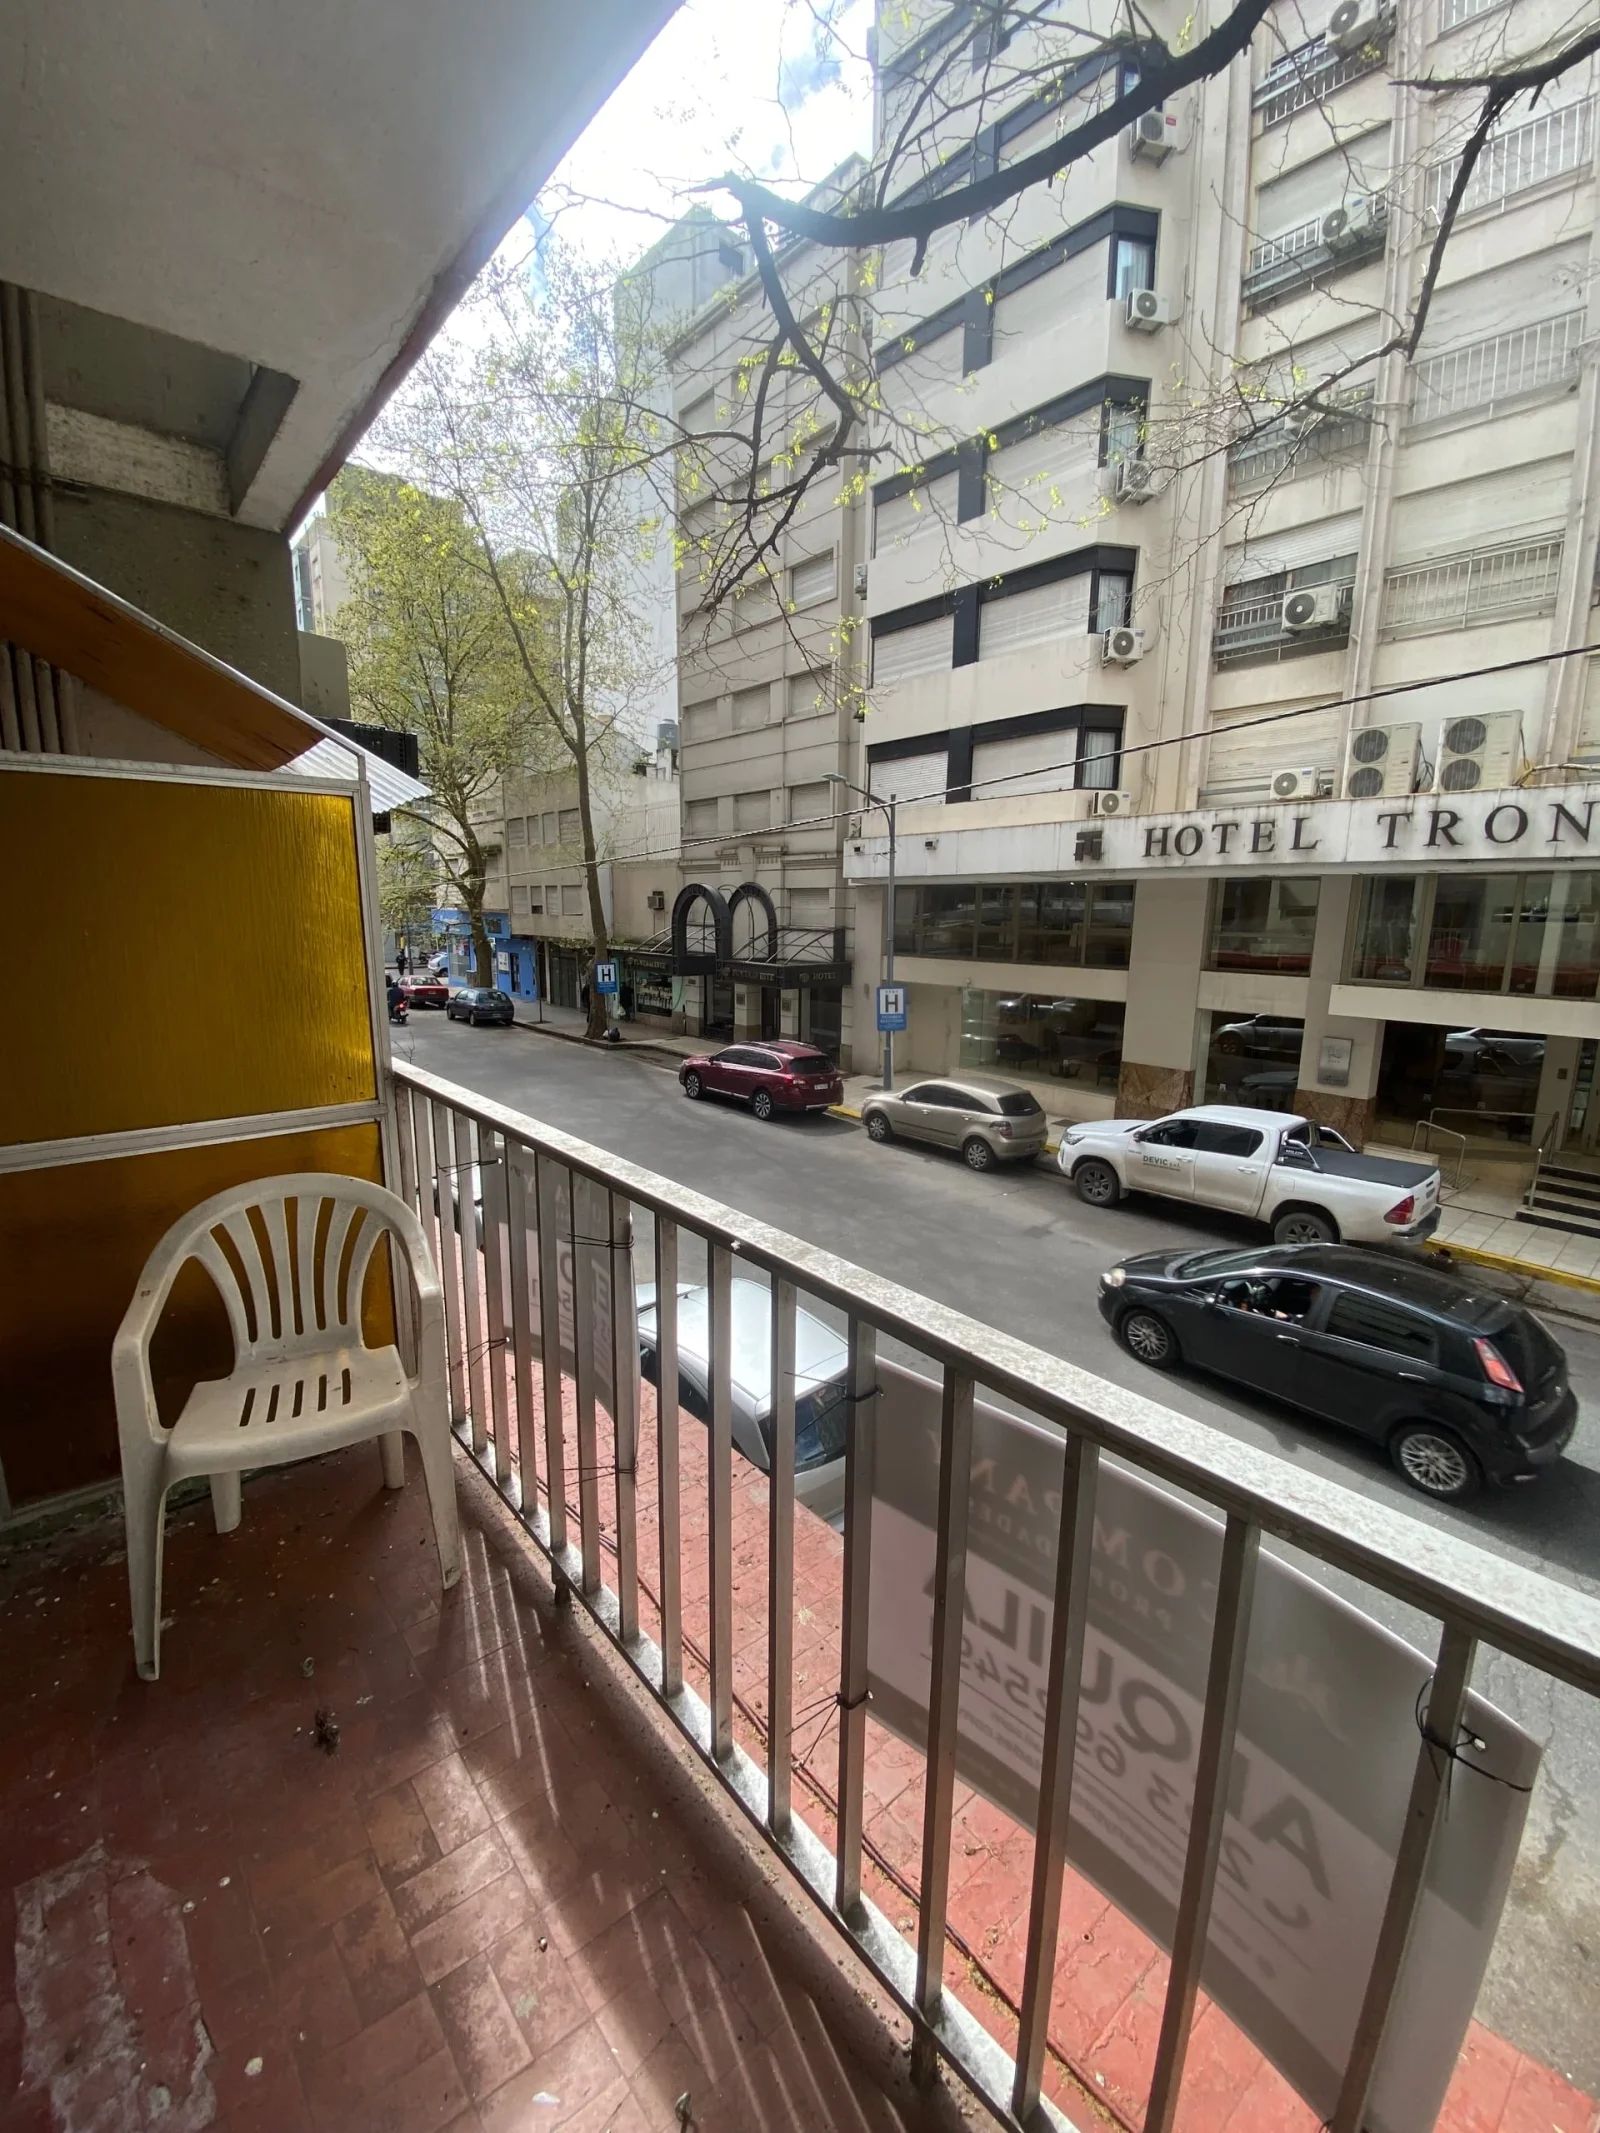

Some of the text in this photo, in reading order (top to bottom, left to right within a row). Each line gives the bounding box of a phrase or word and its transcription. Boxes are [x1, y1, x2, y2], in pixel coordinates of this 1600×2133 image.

[1141, 801, 1600, 859] HOTEL TRON
[601, 968, 611, 981] H
[812, 972, 837, 980] HOTEL
[885, 994, 899, 1013] H
[1143, 1155, 1168, 1166] DEVIC
